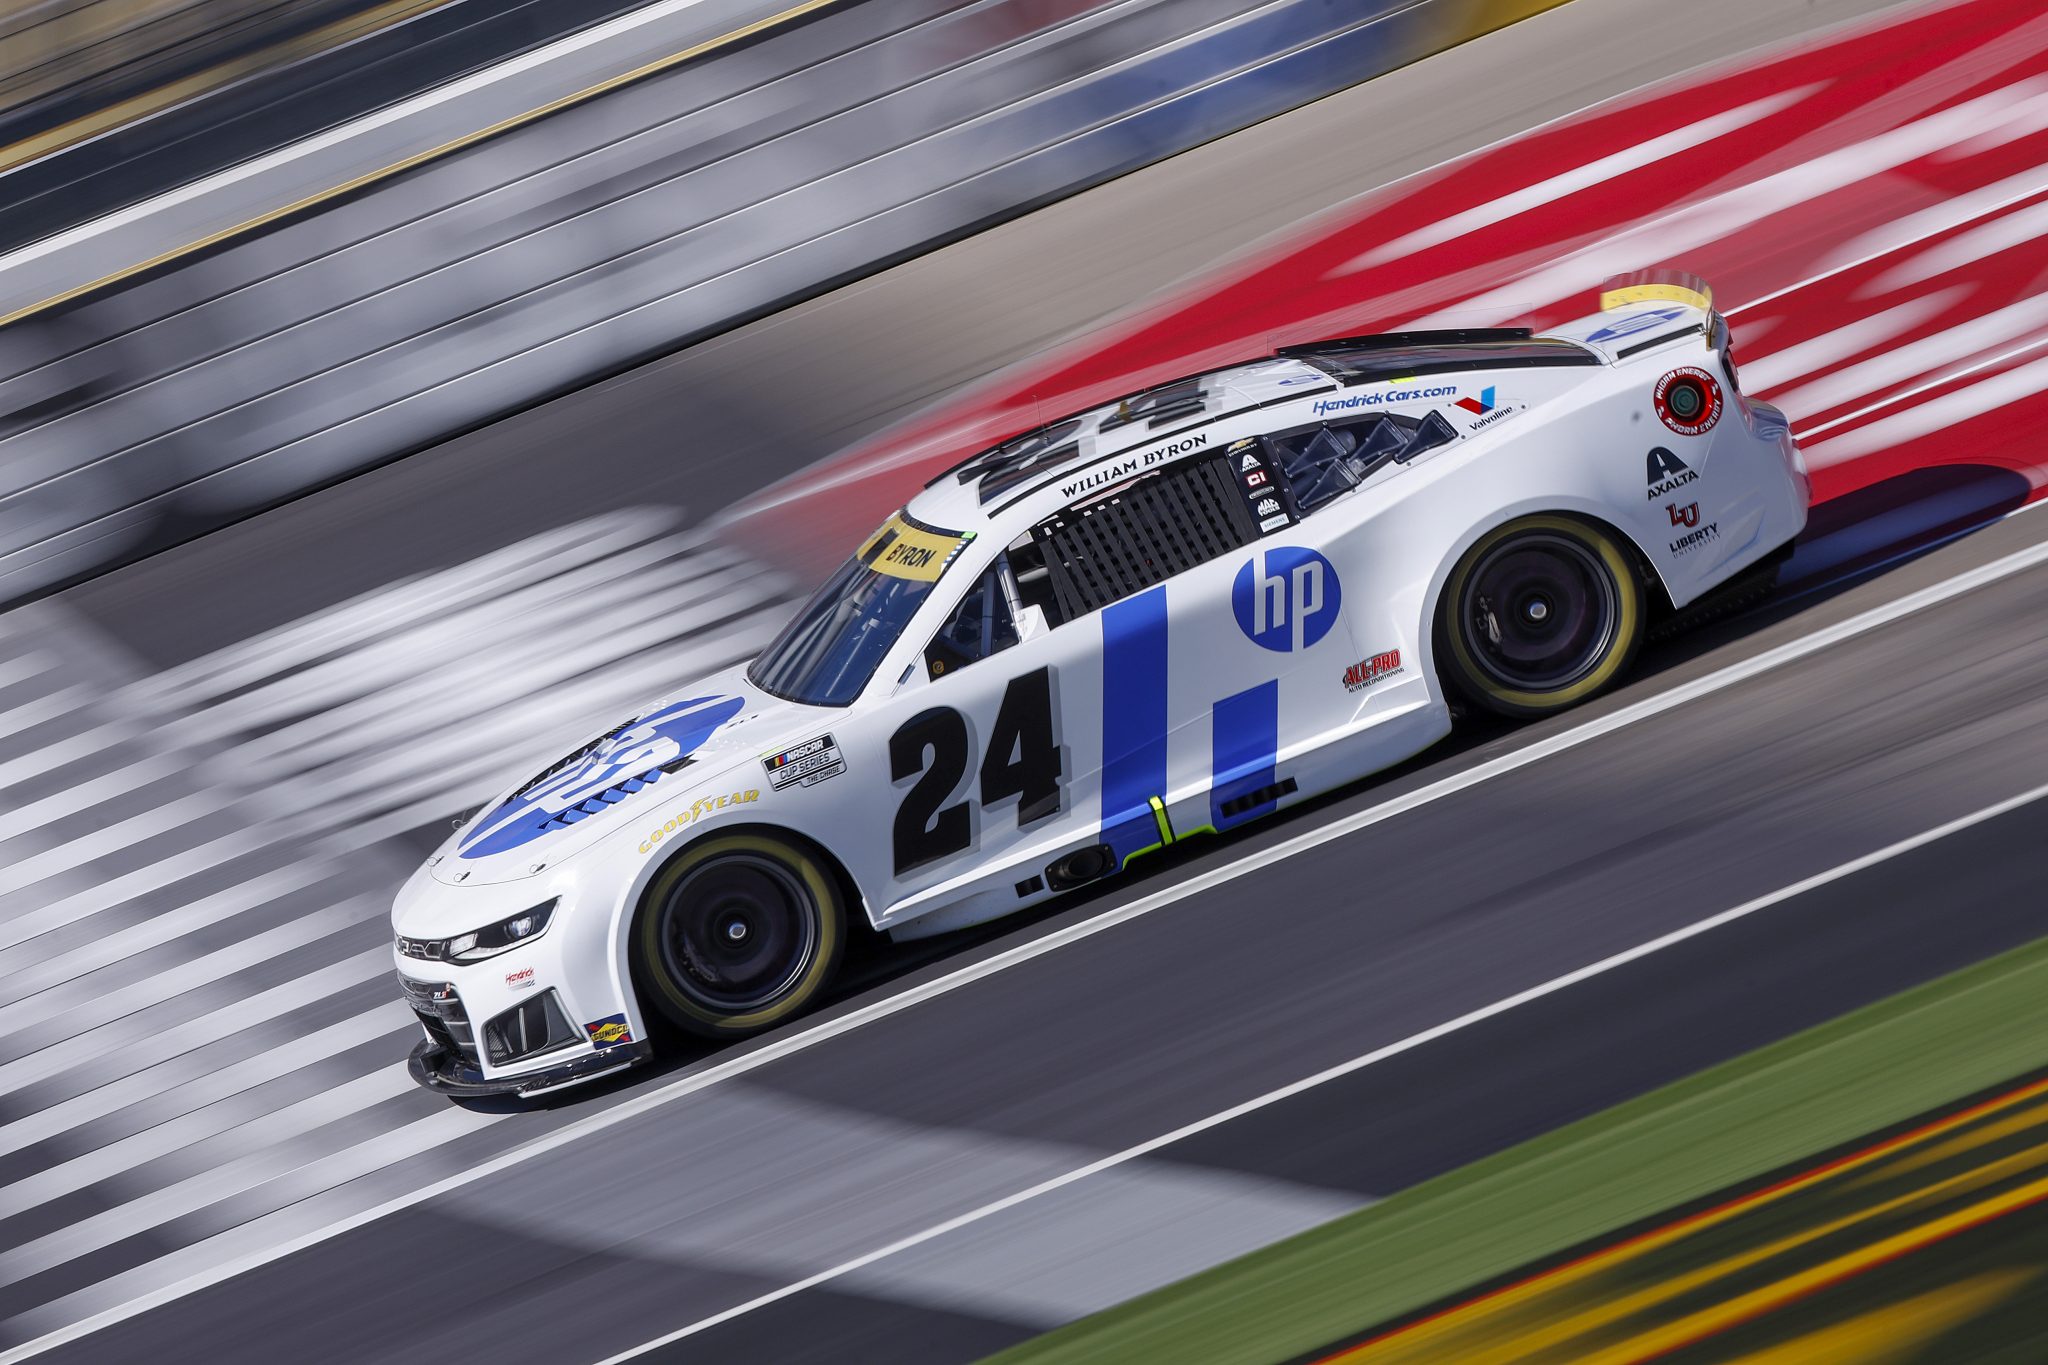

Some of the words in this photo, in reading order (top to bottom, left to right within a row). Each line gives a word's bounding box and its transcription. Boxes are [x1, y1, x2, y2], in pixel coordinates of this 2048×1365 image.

[1469, 406, 1514, 431] Valvoline
[1061, 459, 1138, 498] WILLIAM
[1144, 433, 1207, 466] BYRON
[1647, 470, 1699, 501] AXALTA
[1665, 501, 1700, 528] LU
[1669, 522, 1718, 552] LIBERTY
[885, 543, 937, 568] BYRON
[1253, 547, 1324, 652] hp
[1344, 648, 1401, 689] ALL-PRO
[788, 739, 824, 761] NASCAR
[780, 765, 798, 780] CUP
[799, 752, 830, 772] SERIES
[807, 774, 819, 784] THE
[889, 665, 1063, 878] 24
[639, 789, 760, 854] GOODYEAR
[591, 1024, 631, 1041] SUNOCO
